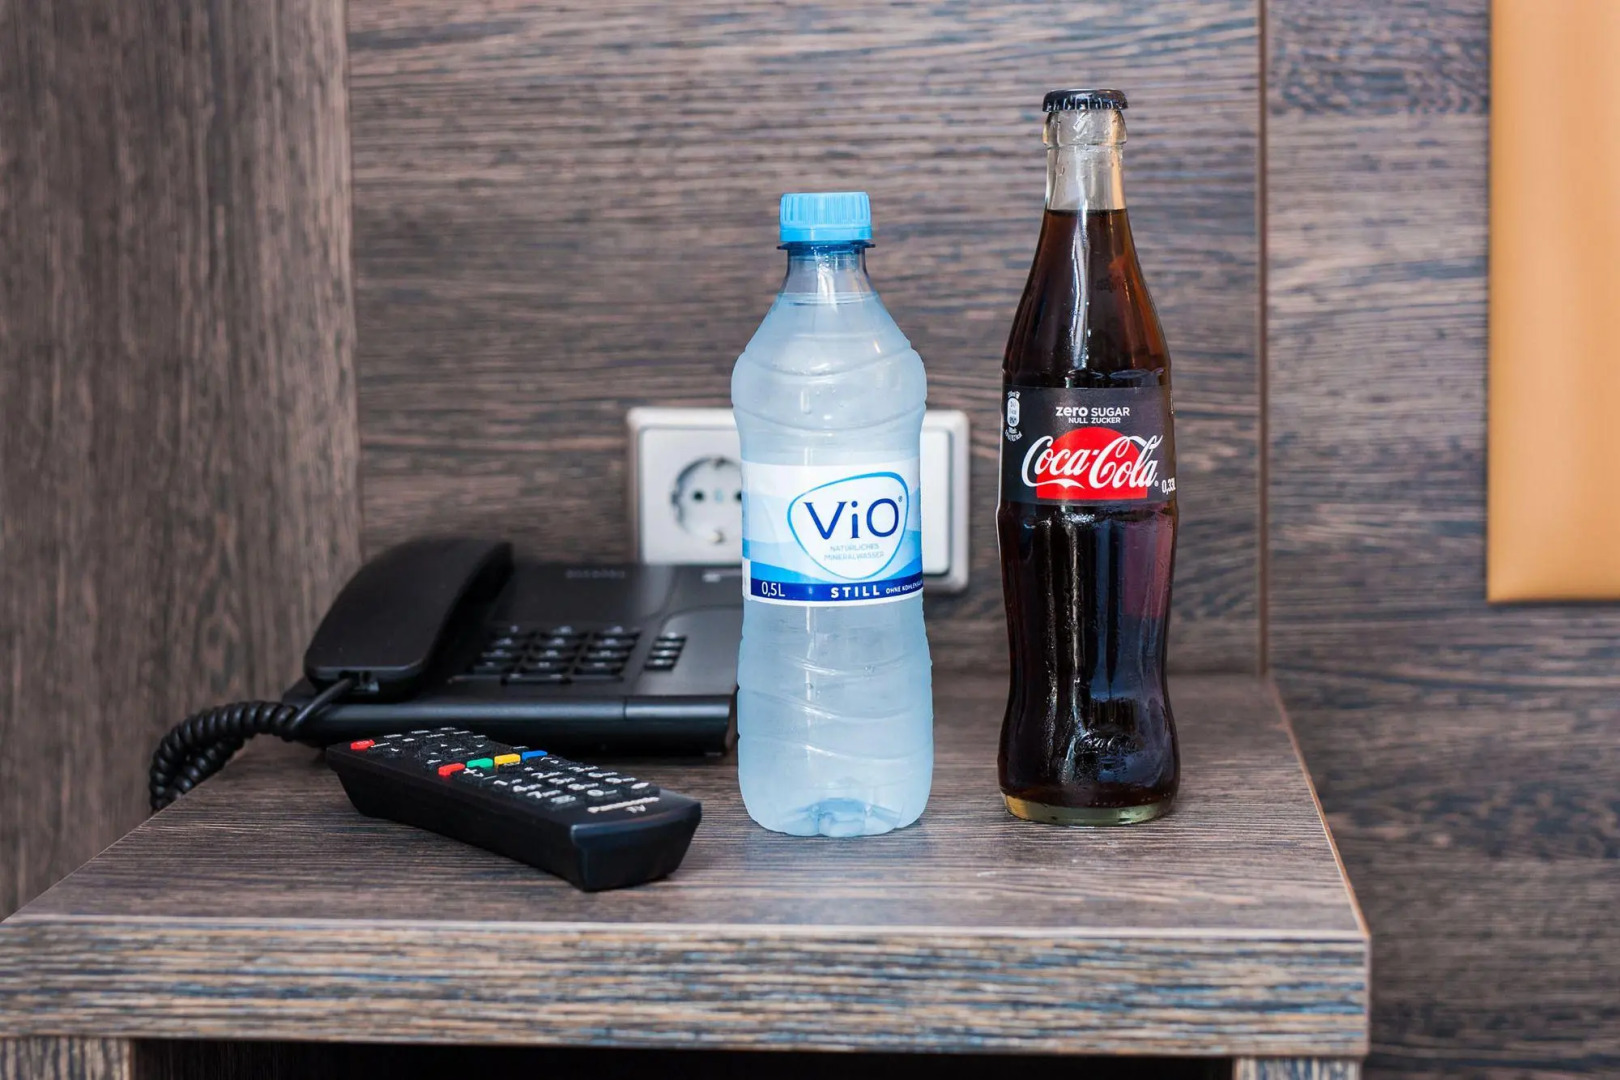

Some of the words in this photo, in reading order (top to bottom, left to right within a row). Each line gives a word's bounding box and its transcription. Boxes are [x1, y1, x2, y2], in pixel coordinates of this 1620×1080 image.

[1055, 406, 1089, 417] zero
[1090, 406, 1130, 417] SUGAR
[1090, 416, 1121, 424] ZUCKER
[1021, 434, 1164, 489] Coca-Cola
[761, 581, 786, 597] 0,5L
[830, 584, 880, 599] STILL
